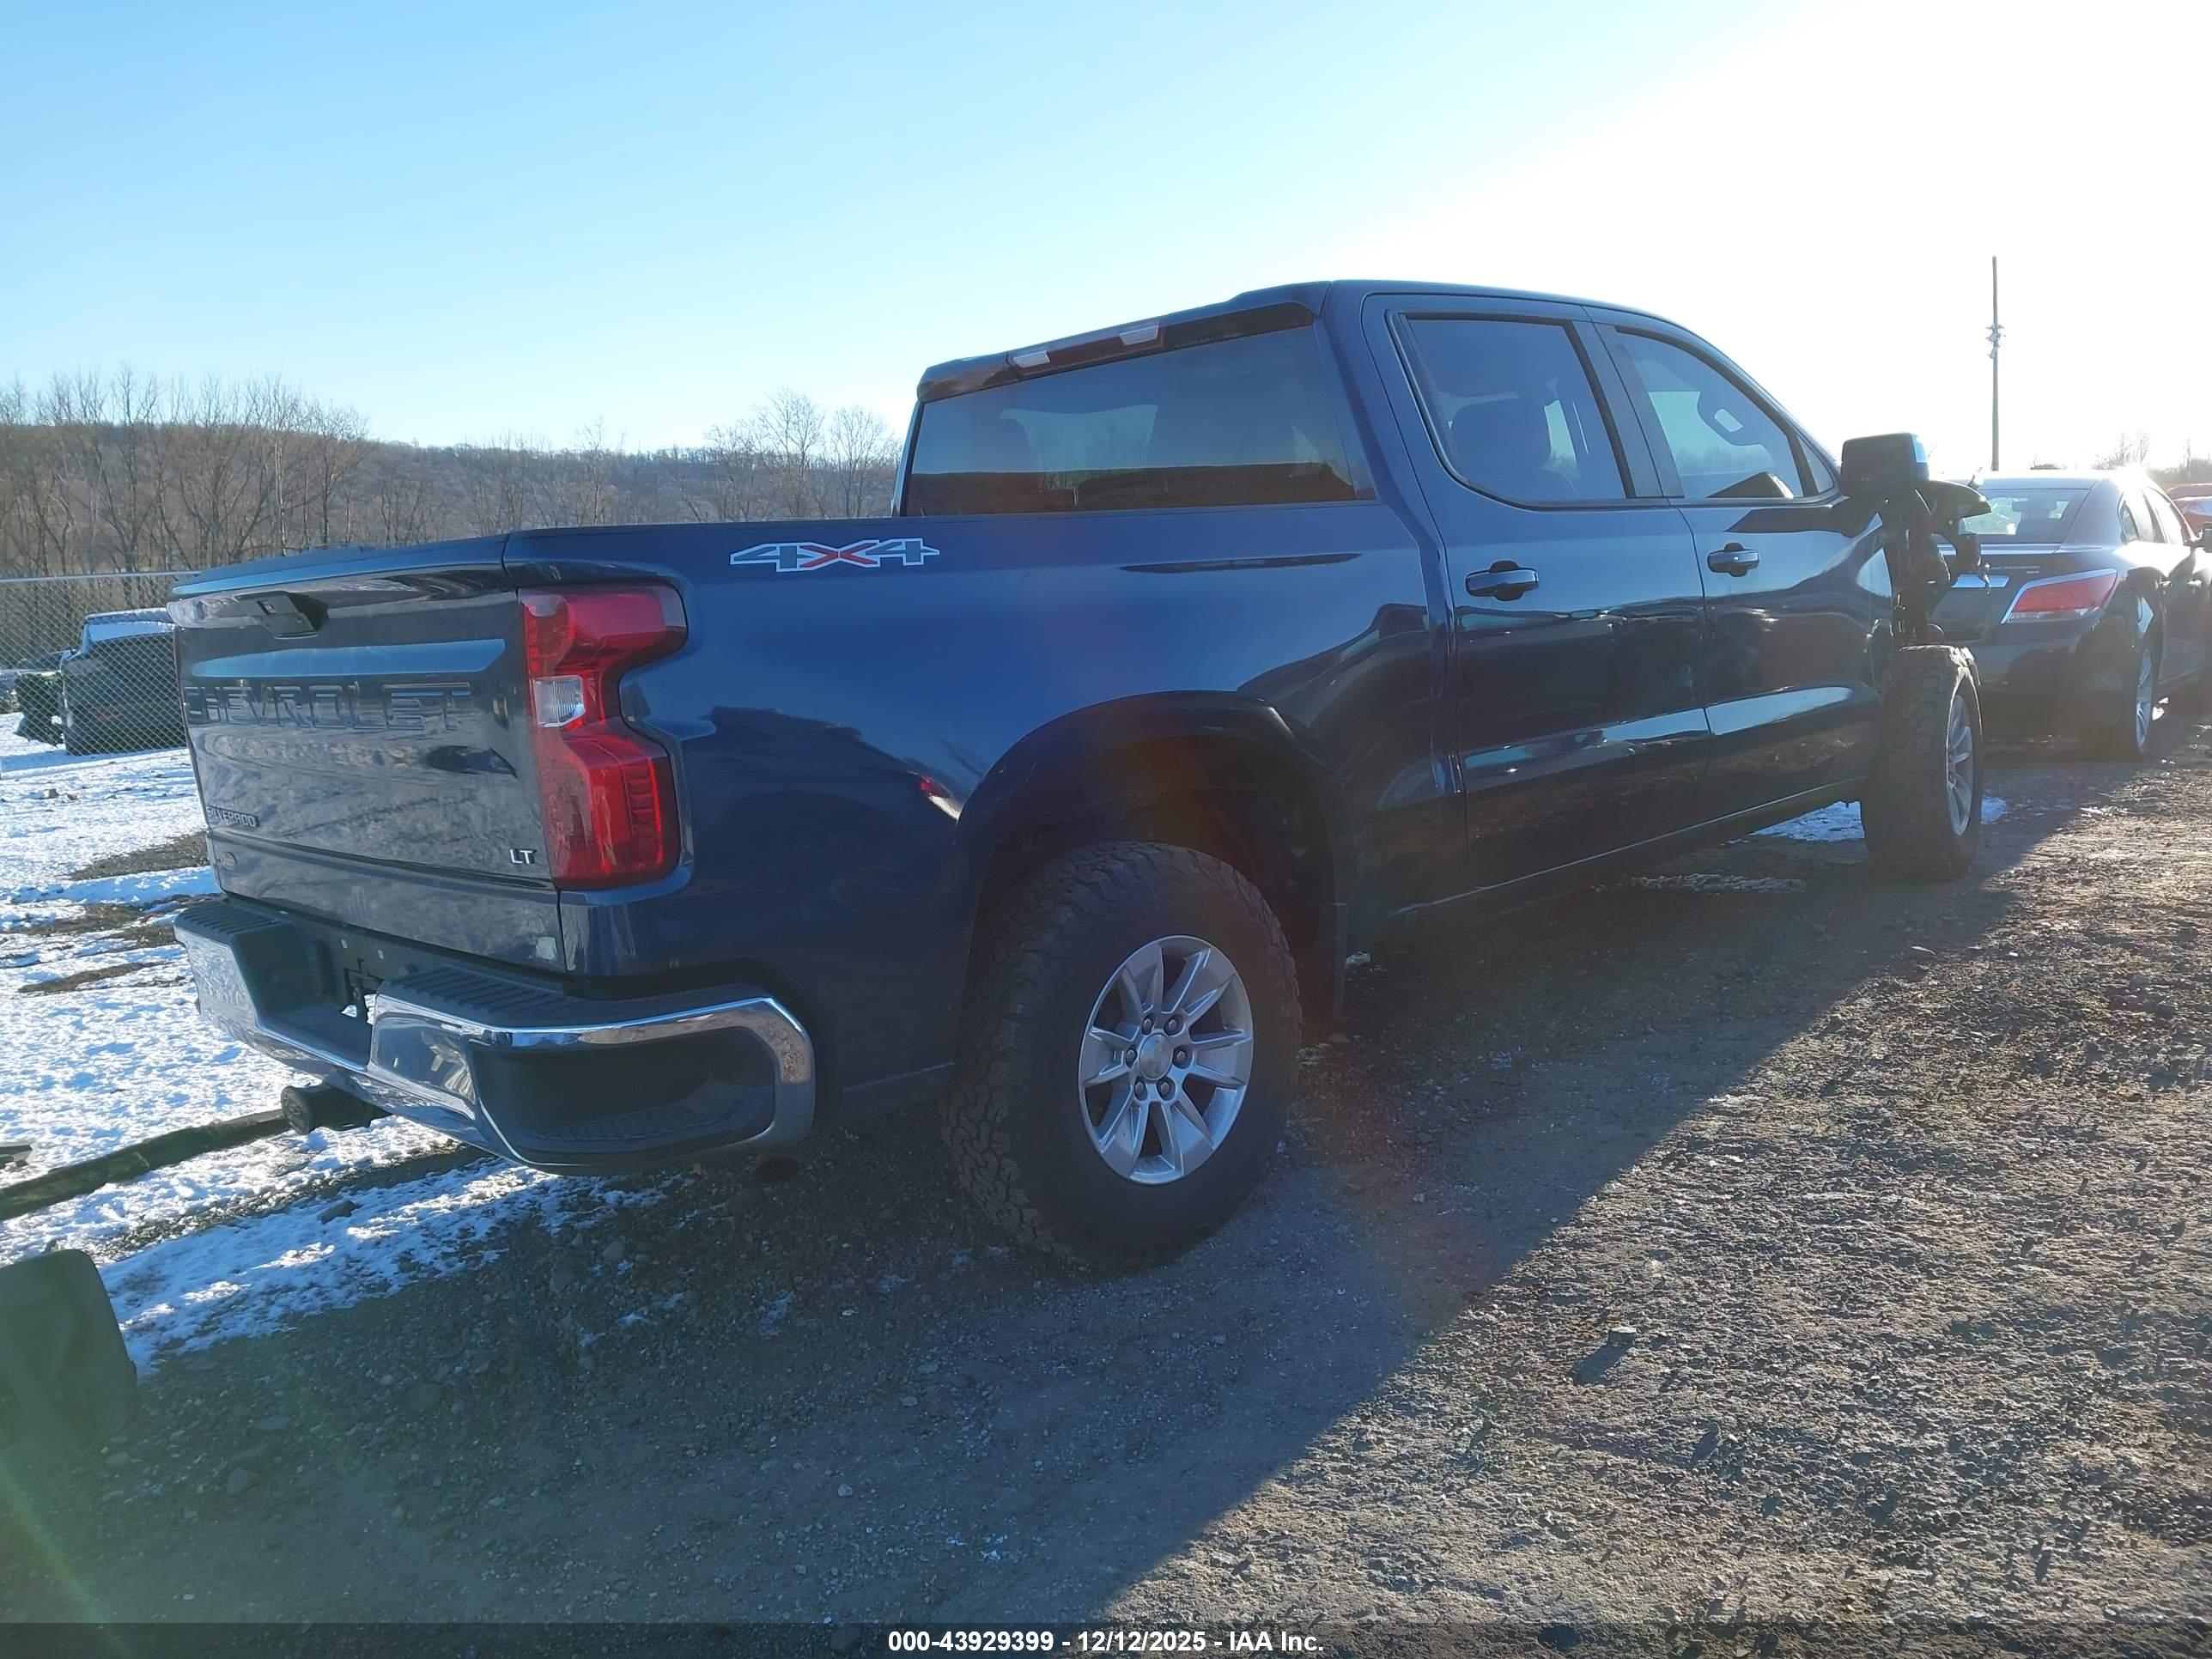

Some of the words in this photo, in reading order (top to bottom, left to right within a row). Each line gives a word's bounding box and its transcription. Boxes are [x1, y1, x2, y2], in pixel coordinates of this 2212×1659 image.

[183, 681, 471, 732] CHEVROLET
[206, 806, 256, 828] SILVERADO
[509, 848, 533, 865] LT
